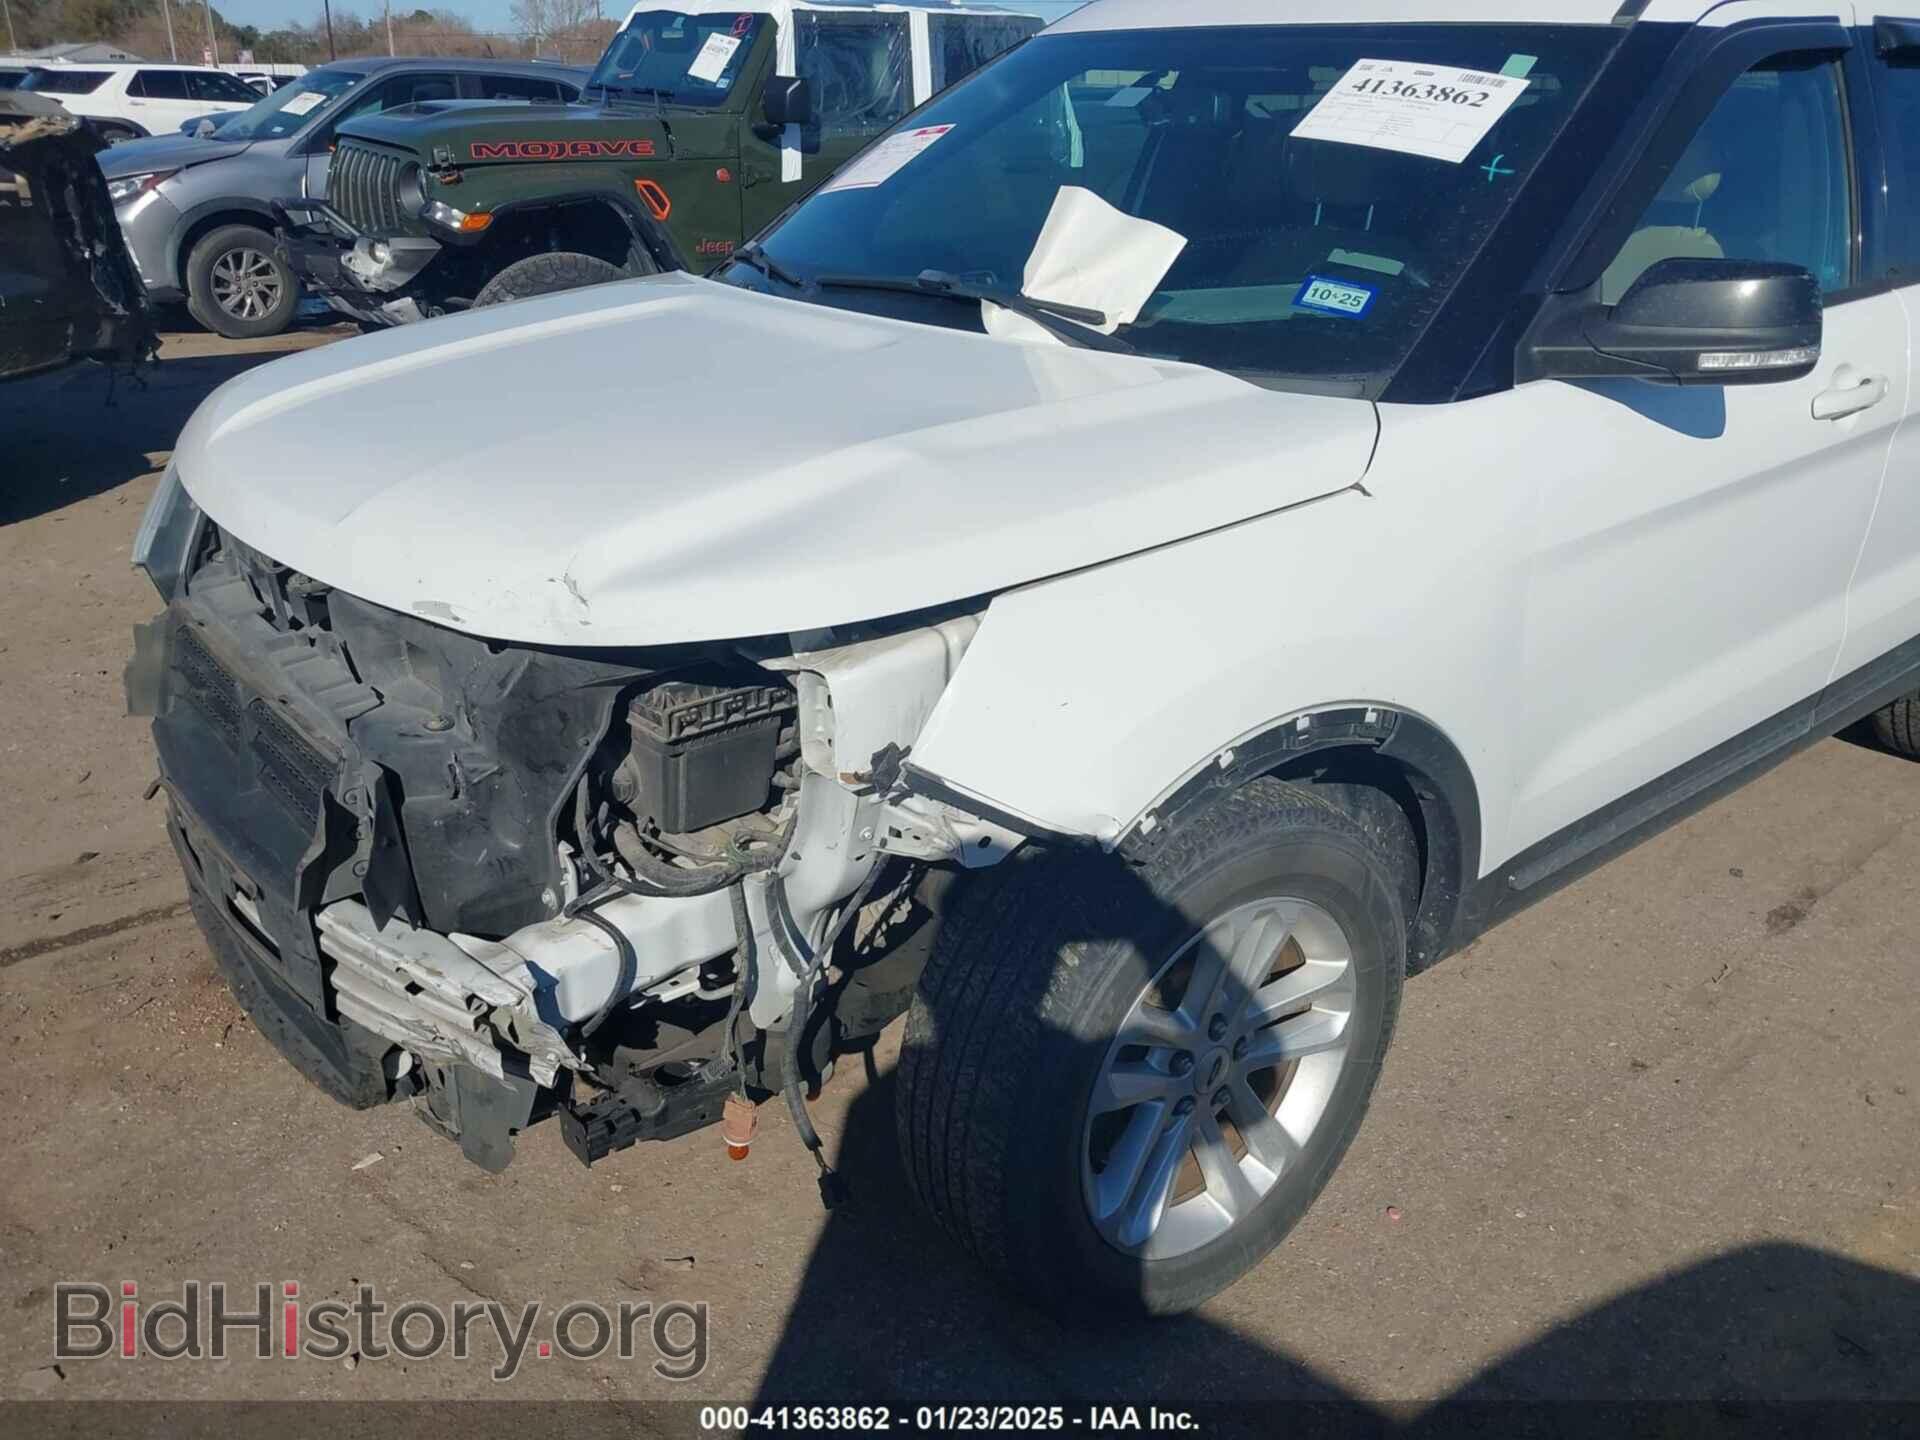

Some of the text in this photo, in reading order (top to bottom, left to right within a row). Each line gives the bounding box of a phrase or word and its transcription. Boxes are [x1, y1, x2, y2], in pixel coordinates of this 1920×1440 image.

[1352, 78, 1489, 108] 41363862
[471, 140, 656, 160] MOJAVE
[696, 238, 734, 256] Jeep
